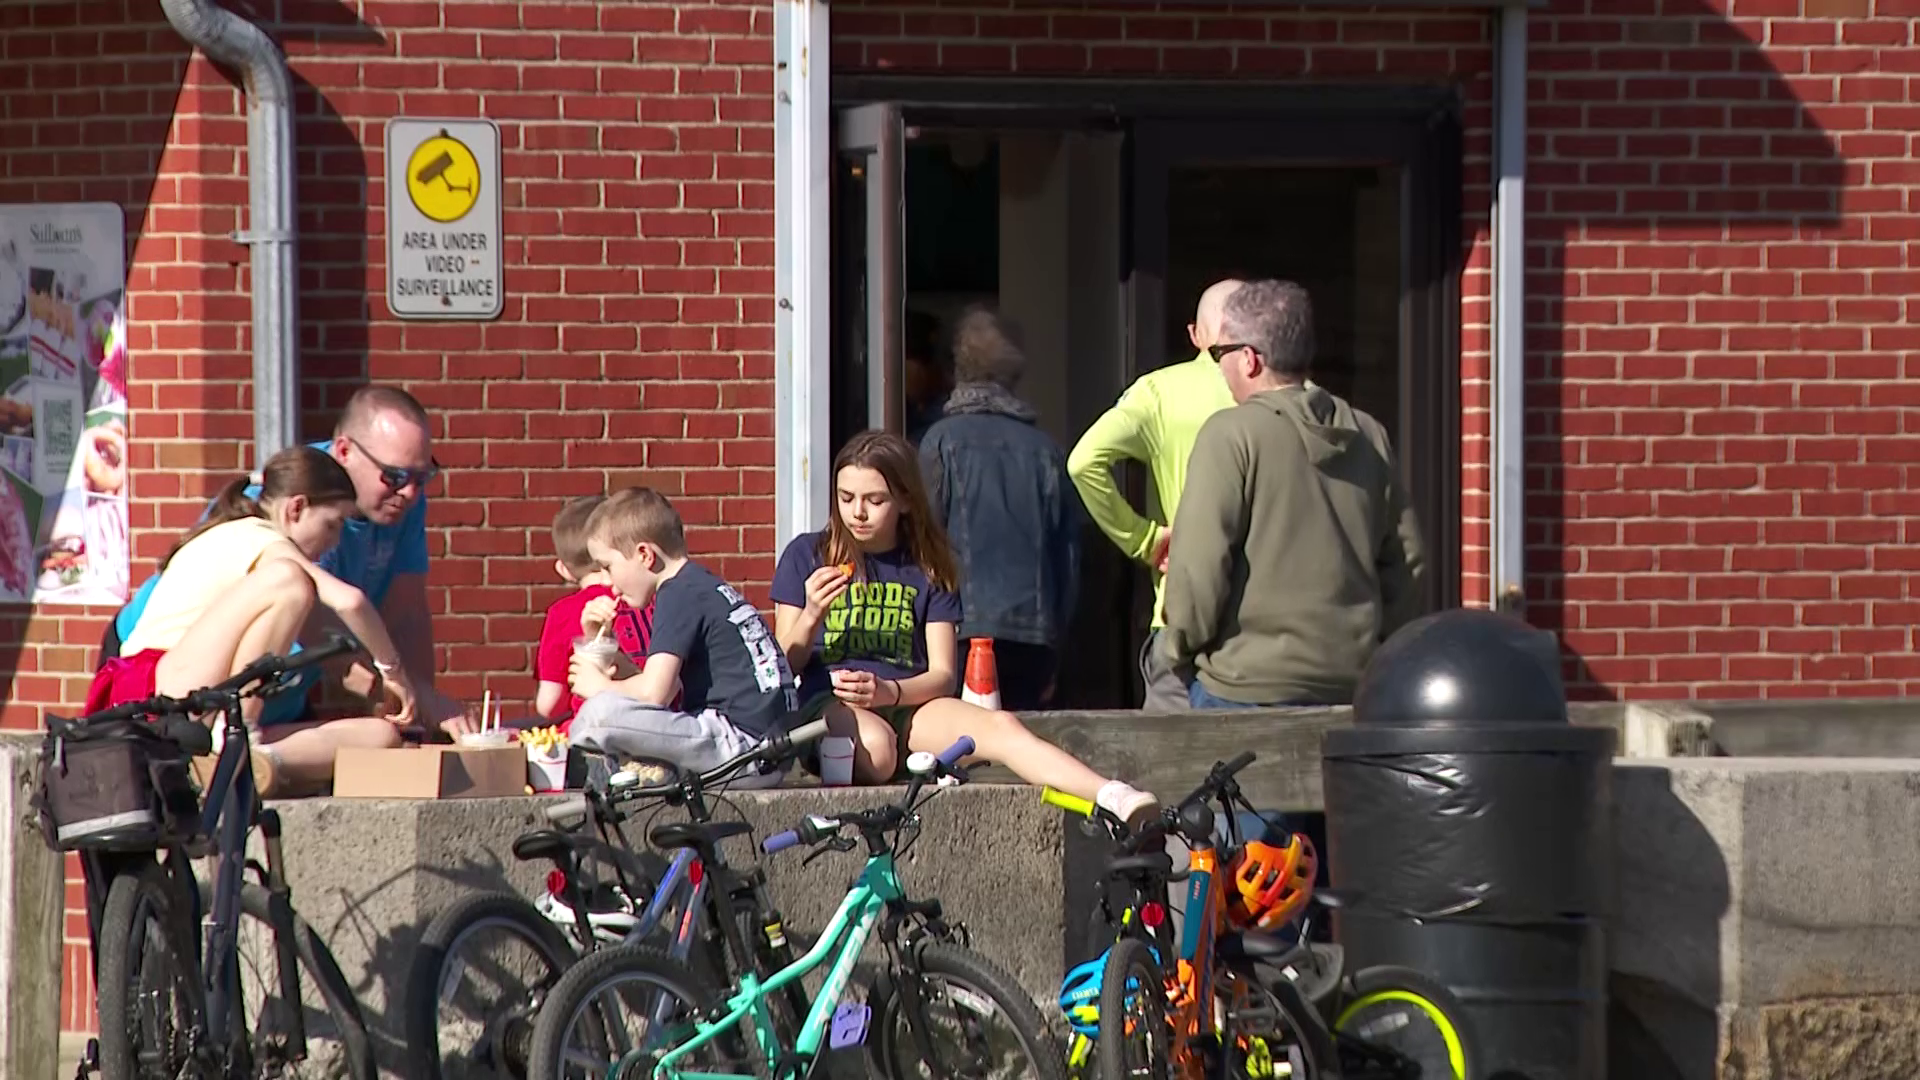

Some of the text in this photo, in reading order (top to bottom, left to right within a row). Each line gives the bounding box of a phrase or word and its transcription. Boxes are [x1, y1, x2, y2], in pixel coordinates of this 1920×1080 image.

[402, 231, 487, 250] AREA UNDER
[425, 255, 465, 273] VIDEO
[397, 278, 493, 296] SURVEILLANCE
[824, 606, 914, 632] WOODS
